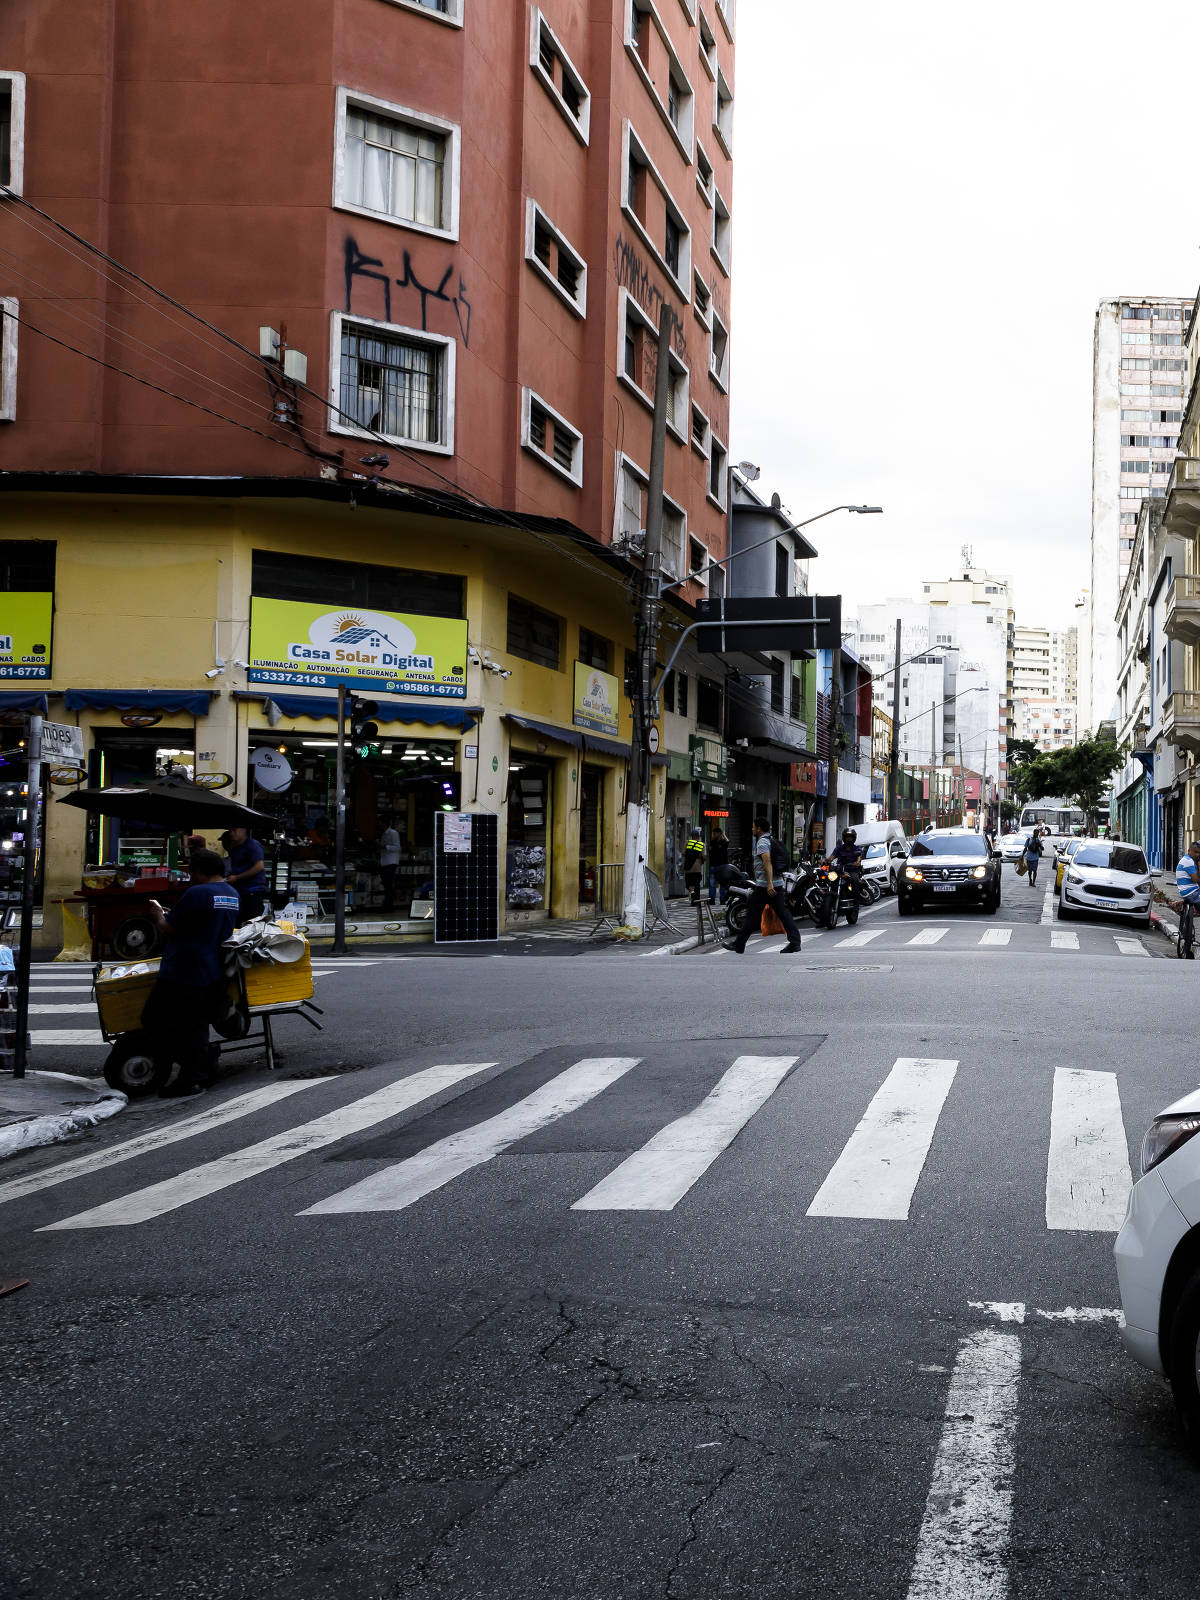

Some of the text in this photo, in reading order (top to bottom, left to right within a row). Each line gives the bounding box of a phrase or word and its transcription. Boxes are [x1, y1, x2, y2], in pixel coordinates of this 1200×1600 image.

[291, 645, 433, 670] Casa Solar Digital
[253, 659, 463, 683] ILUMINAÇÃO AUTOMAÇÃO SEGURANÇA ANTENAS CABOS
[257, 761, 281, 770] Century
